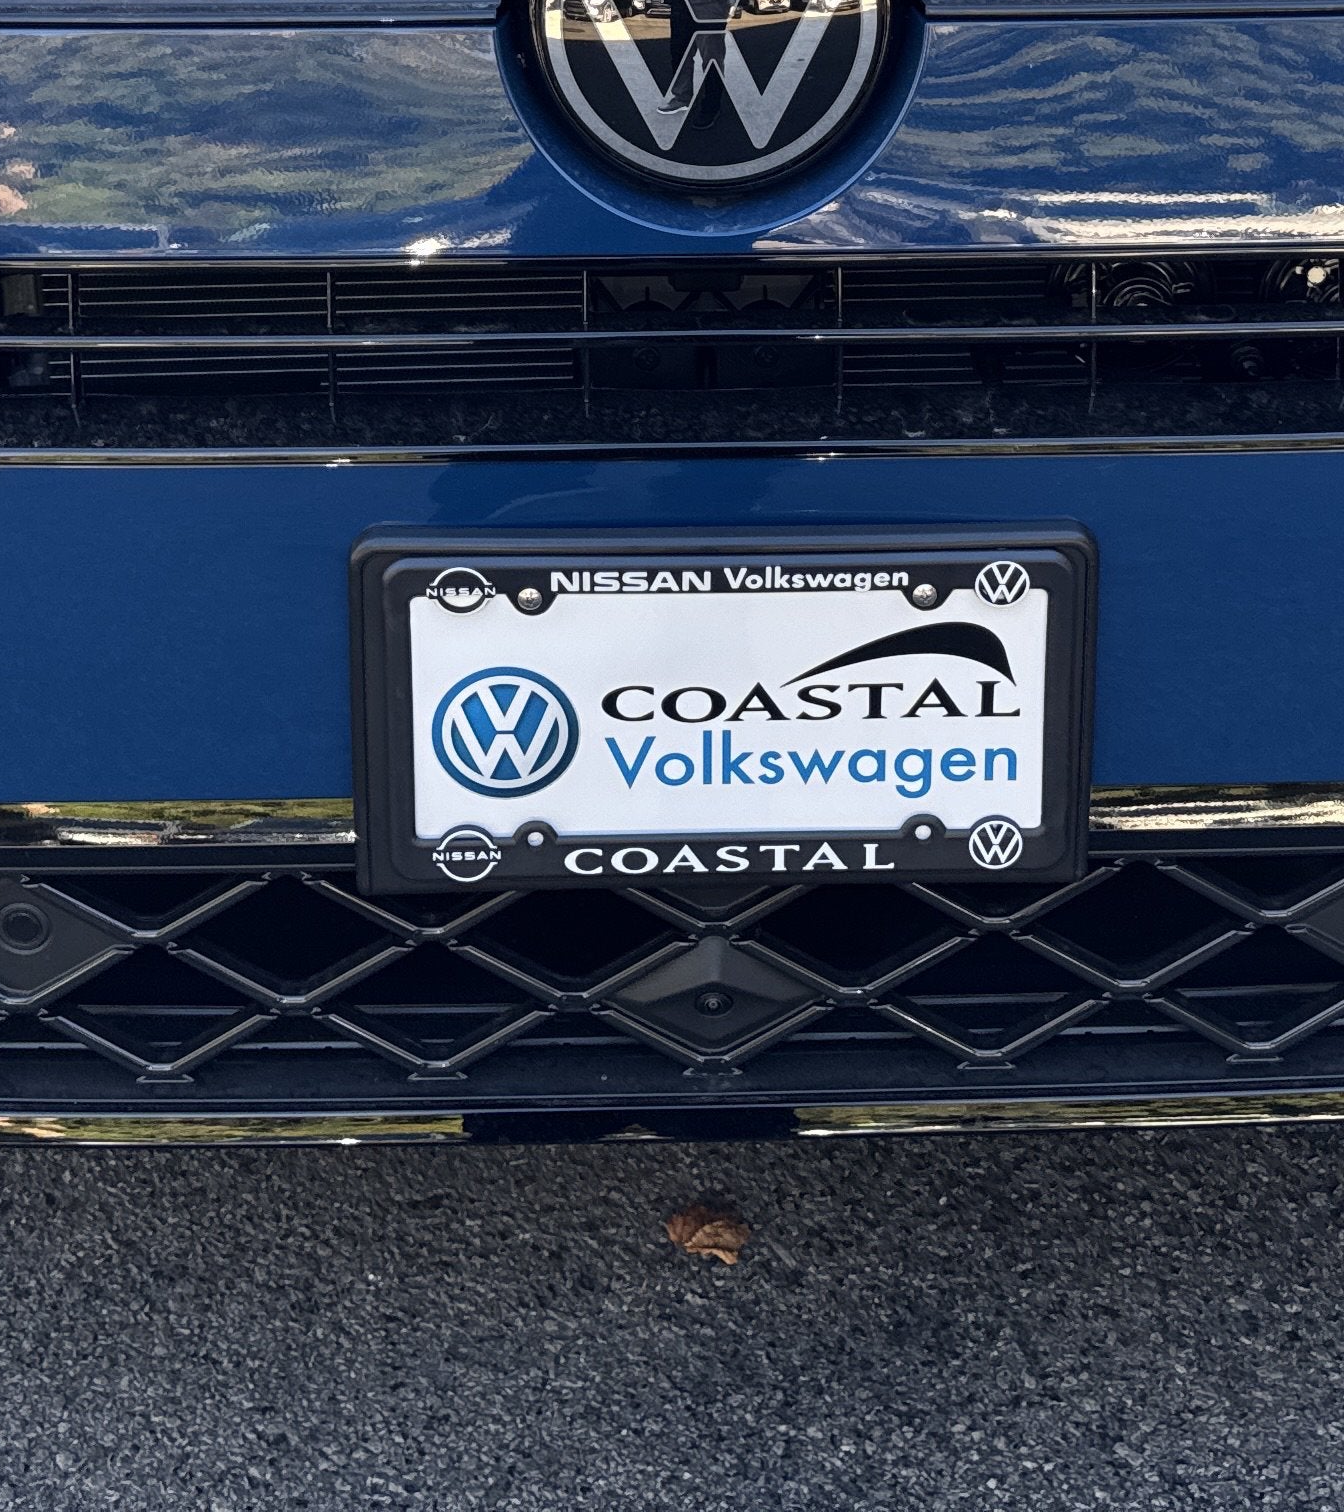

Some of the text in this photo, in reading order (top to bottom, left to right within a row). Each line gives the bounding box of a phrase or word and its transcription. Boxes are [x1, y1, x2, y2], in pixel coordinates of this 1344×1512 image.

[425, 585, 497, 599] NISSAN
[550, 564, 910, 593] NISSAN Volkswagen
[601, 676, 1022, 724] COASTAL
[604, 729, 1019, 799] Volkswagen
[430, 849, 503, 862] NISSAN
[564, 841, 897, 876] COASTAL
